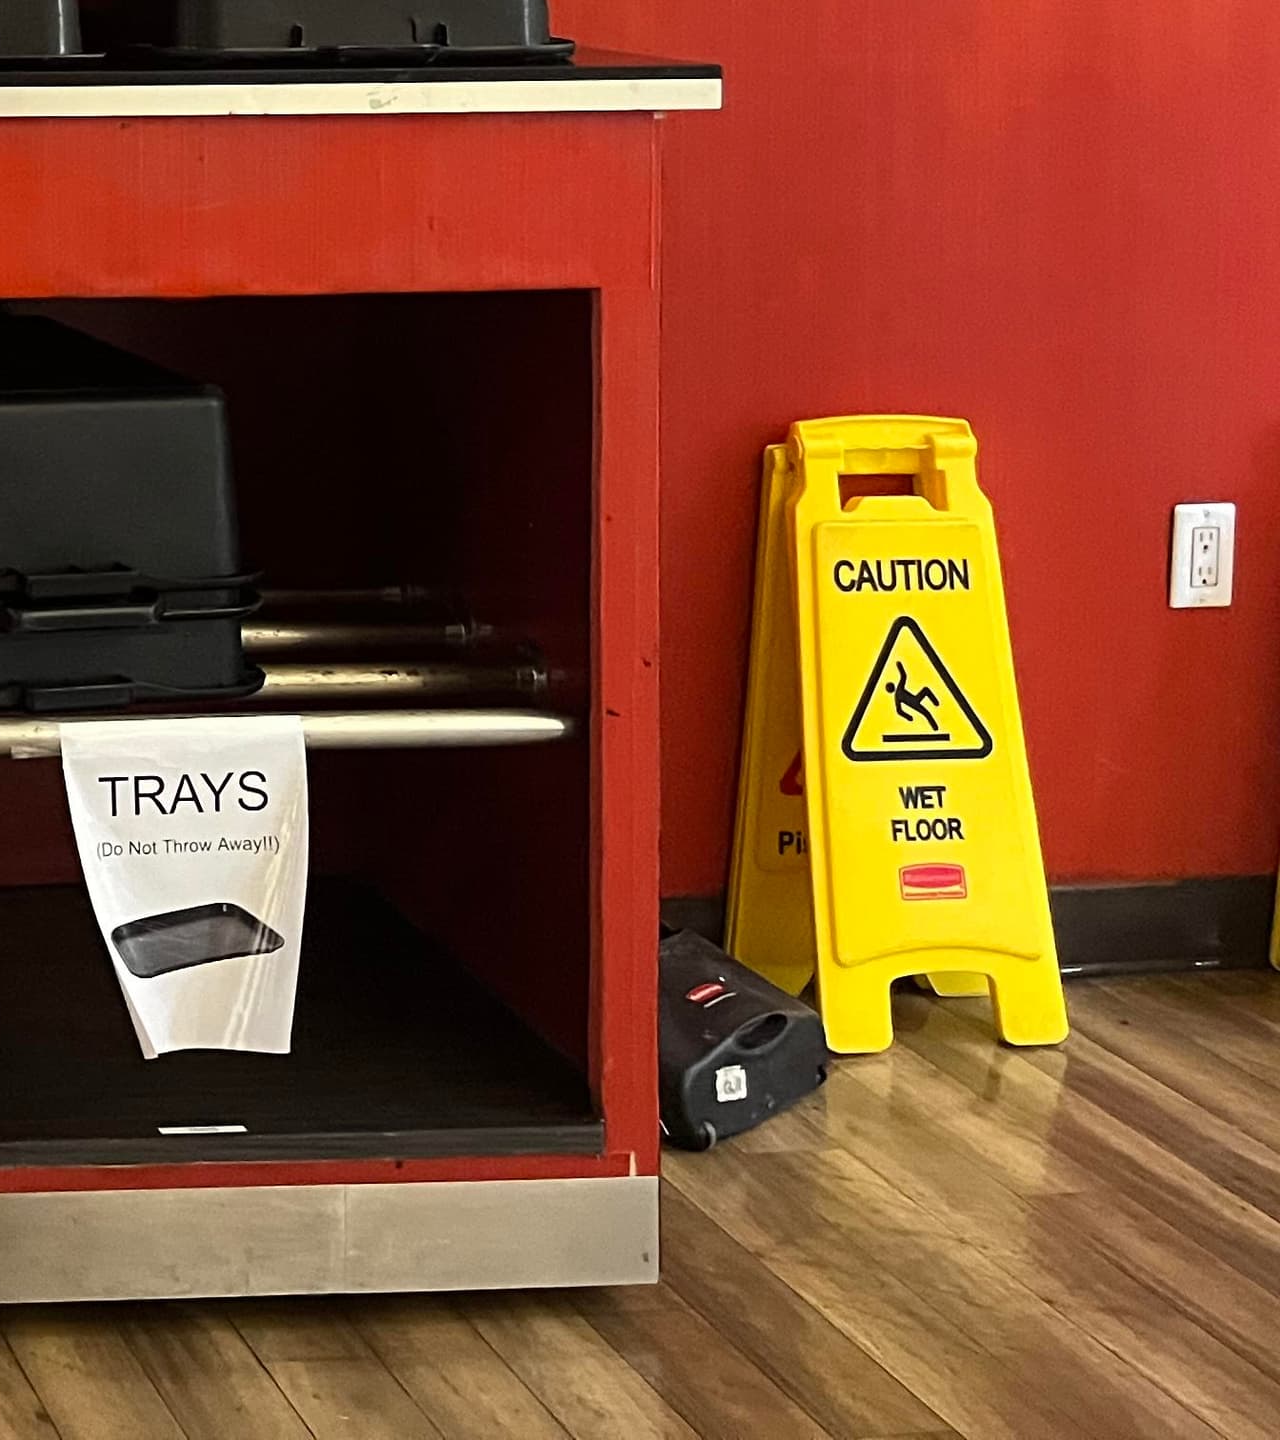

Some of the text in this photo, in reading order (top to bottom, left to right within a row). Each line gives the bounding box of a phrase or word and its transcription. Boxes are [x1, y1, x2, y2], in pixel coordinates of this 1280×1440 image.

[833, 558, 970, 592] CAUTION
[98, 770, 269, 817] TRAYS
[898, 785, 947, 809] WET
[891, 817, 965, 842] FLOOR
[96, 835, 281, 860] (Do Not Throw Away!!)
[778, 830, 807, 856] Pi
